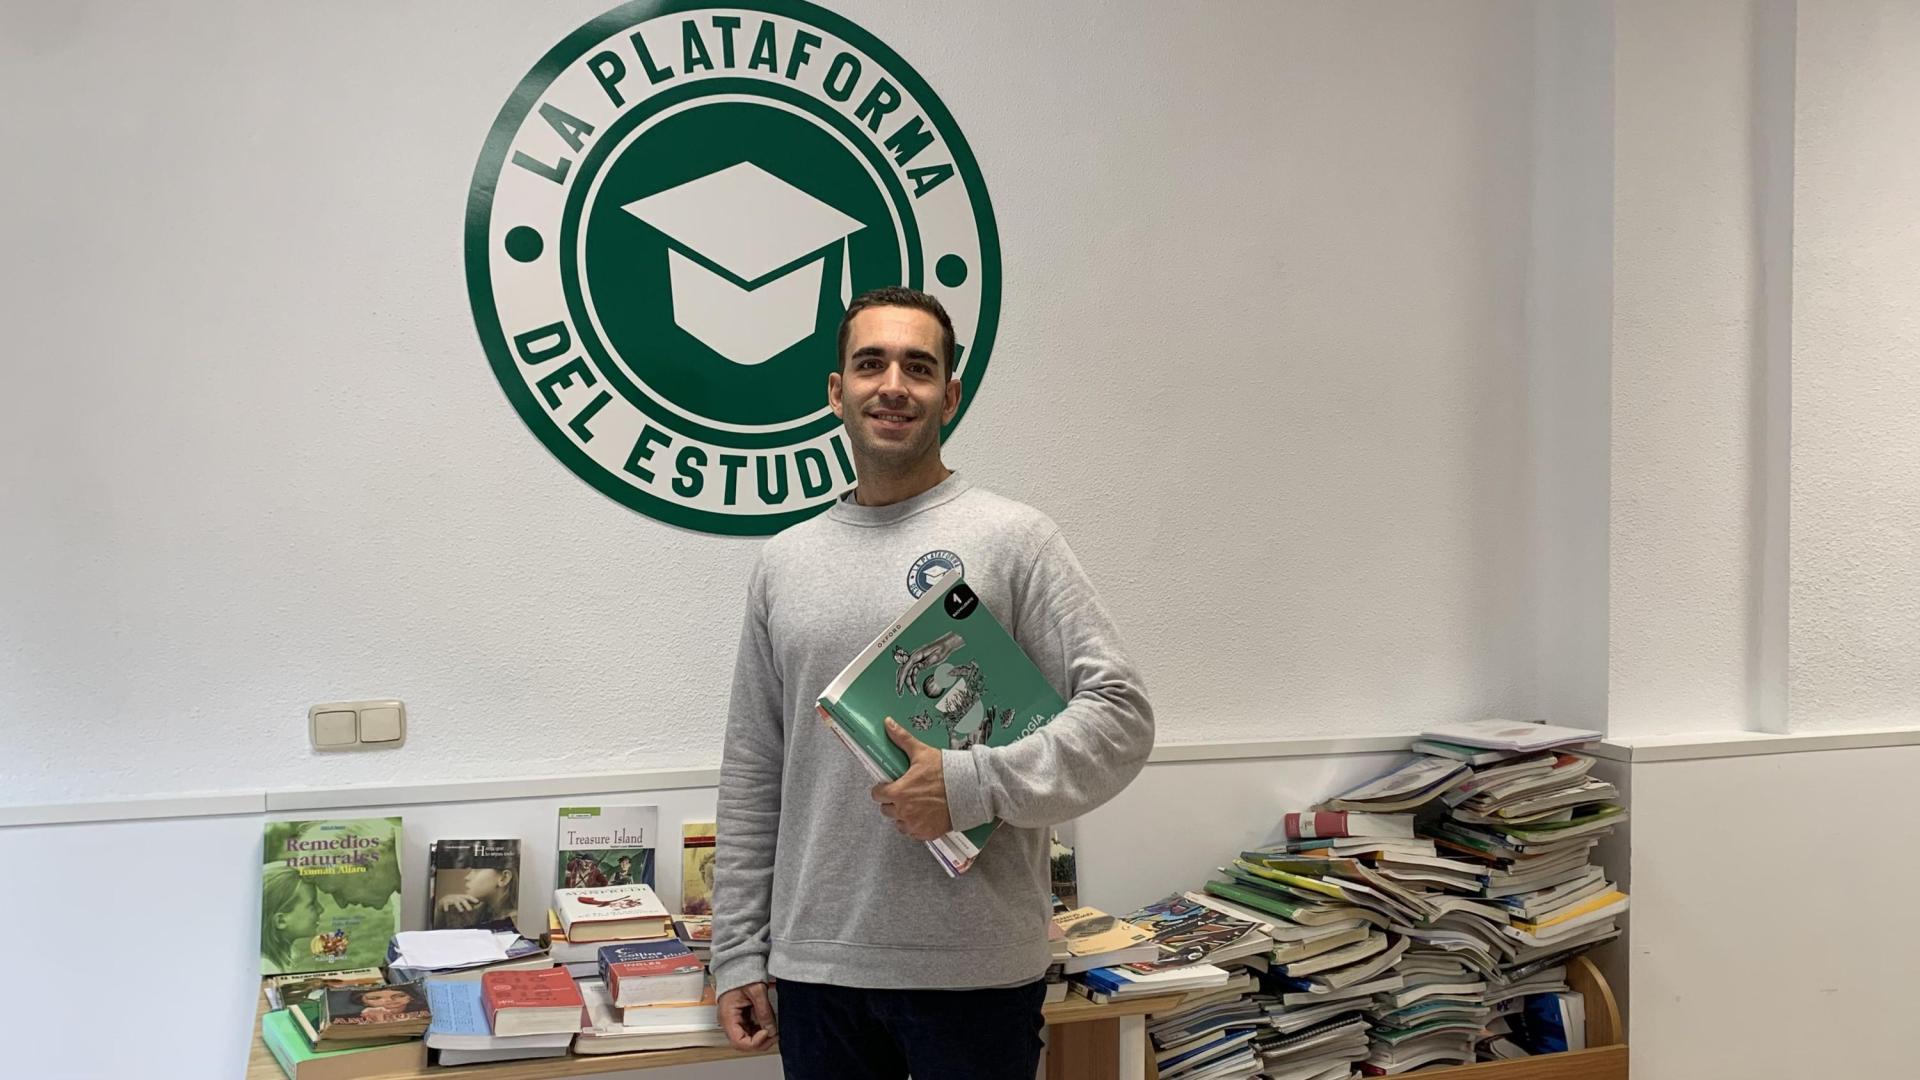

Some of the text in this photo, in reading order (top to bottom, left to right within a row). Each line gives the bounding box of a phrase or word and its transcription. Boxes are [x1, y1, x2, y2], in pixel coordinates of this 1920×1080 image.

[511, 15, 954, 199] LA PLATAFORMA
[513, 320, 613, 445] DEL
[952, 592, 962, 604] 1
[877, 624, 902, 648] OXFORD
[287, 834, 380, 852] Remedios
[567, 827, 644, 845] Treasure Island
[286, 850, 380, 868] naturales
